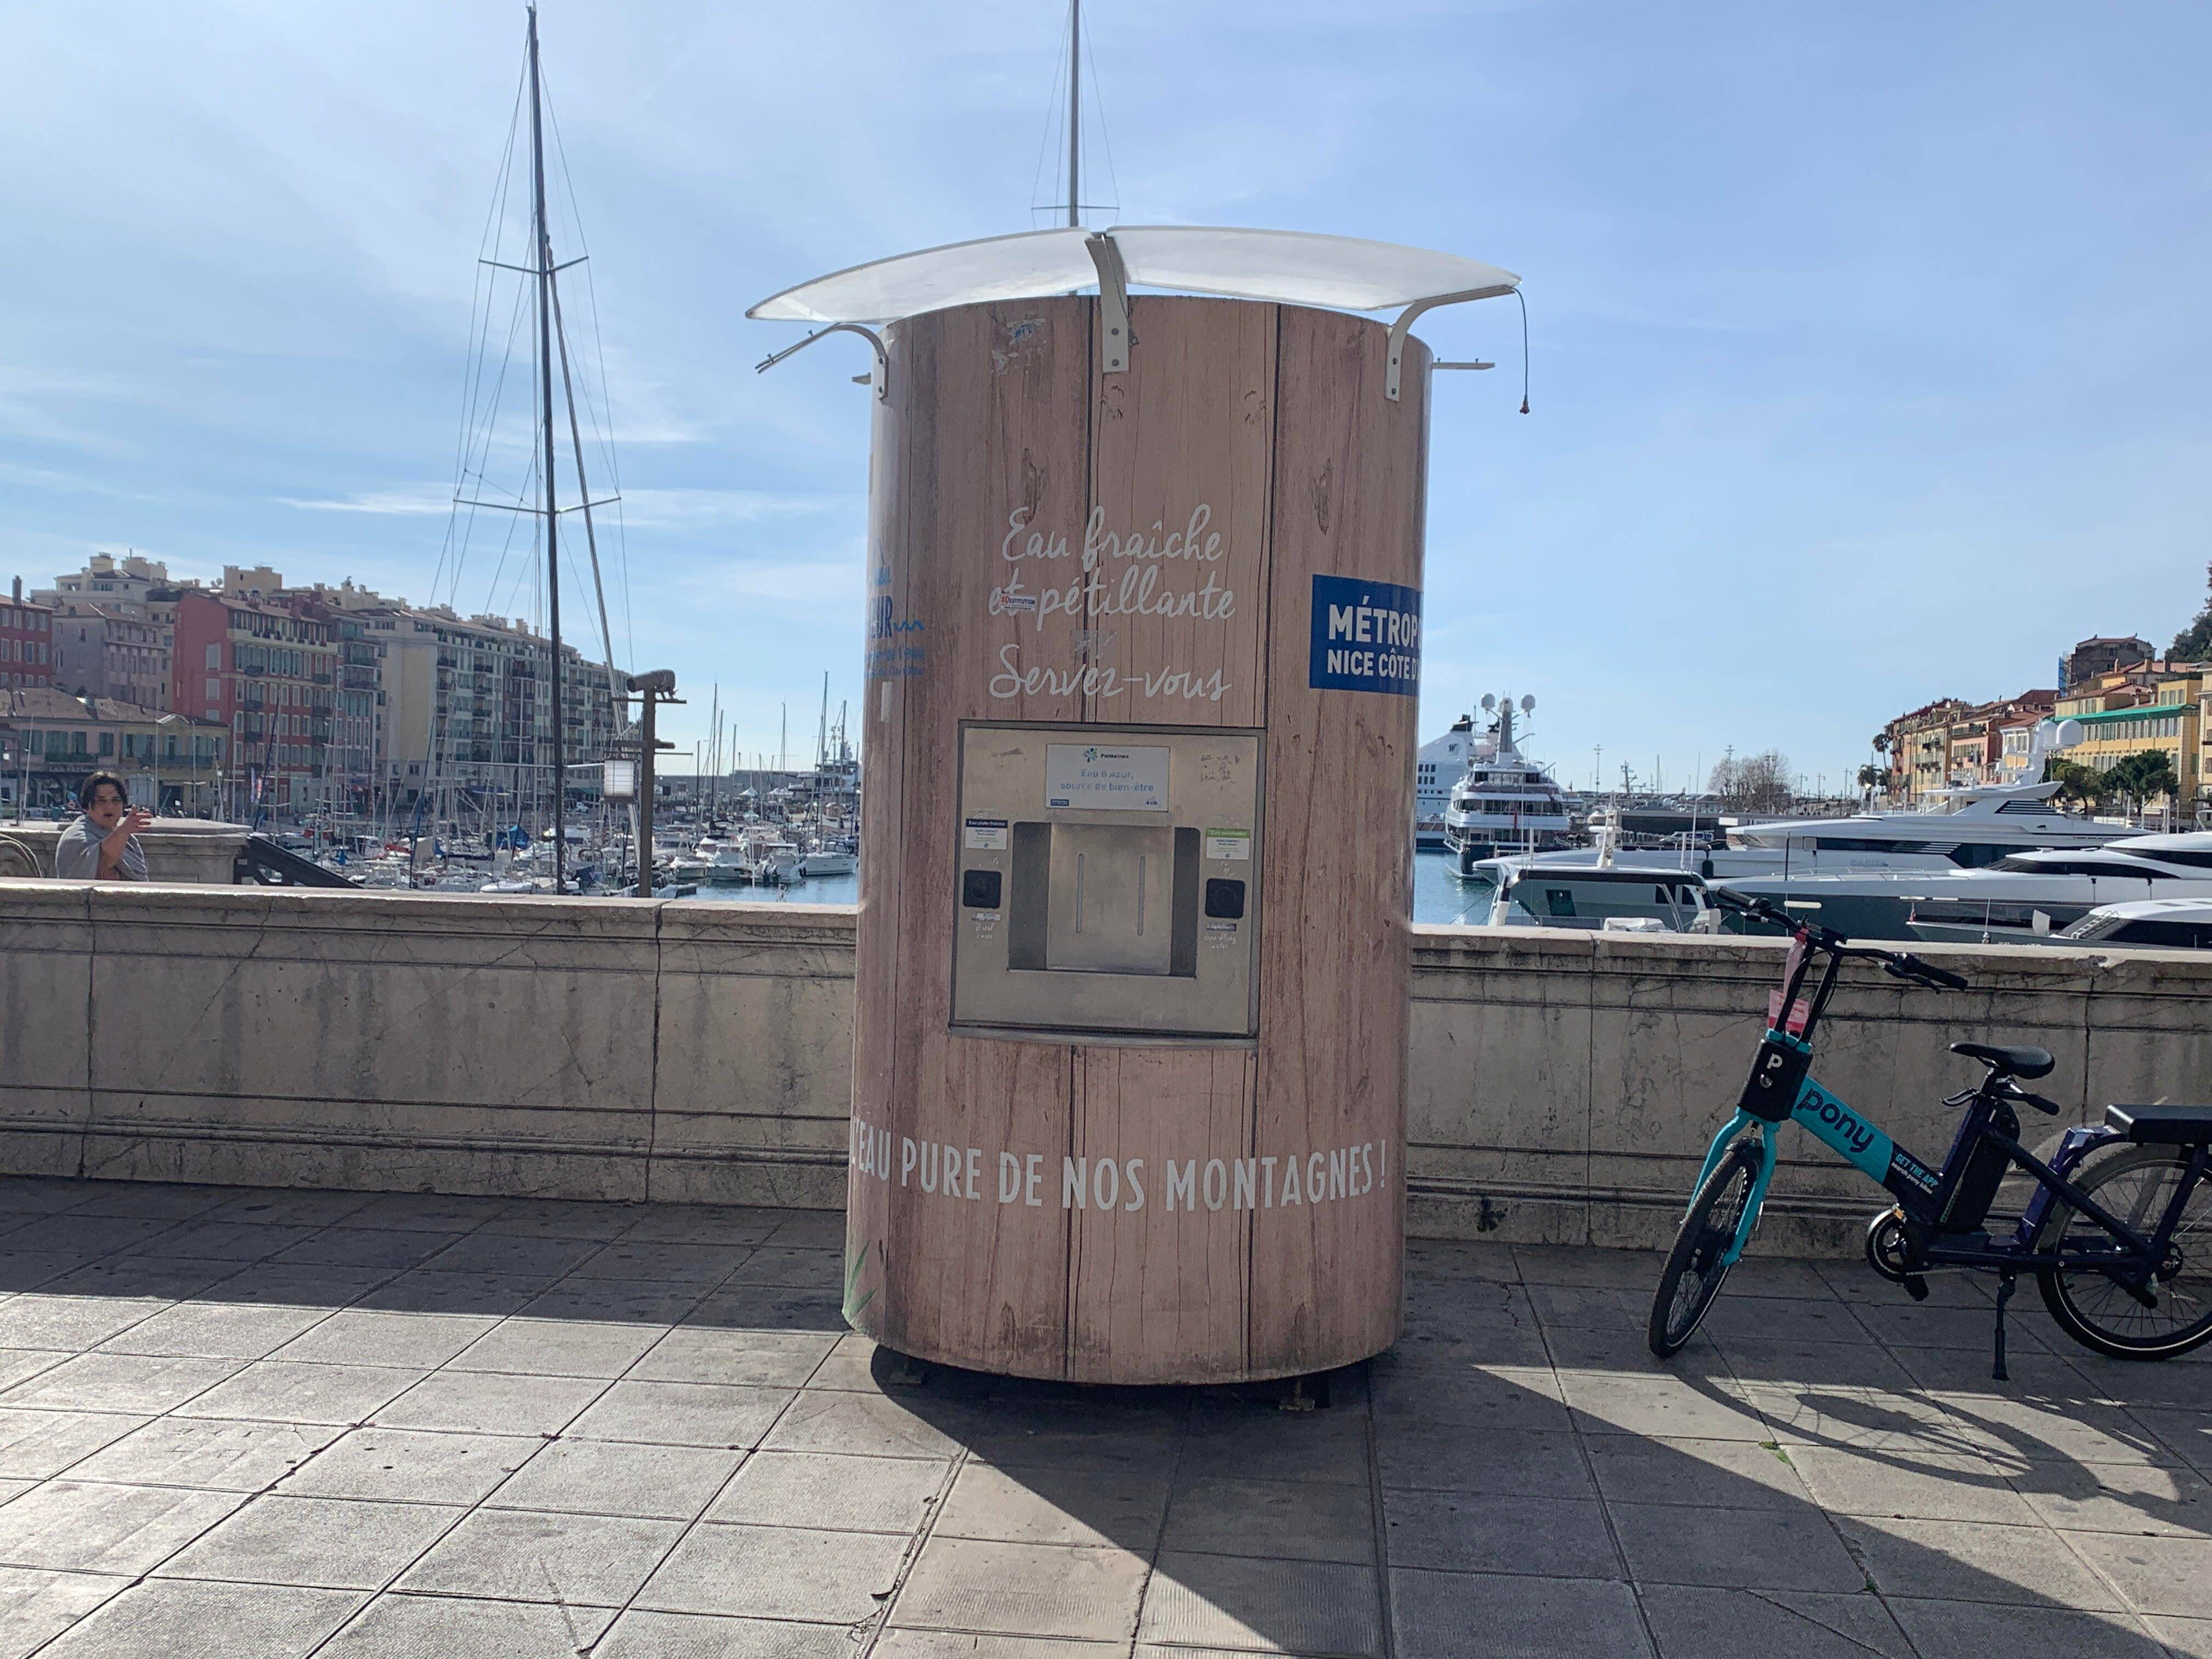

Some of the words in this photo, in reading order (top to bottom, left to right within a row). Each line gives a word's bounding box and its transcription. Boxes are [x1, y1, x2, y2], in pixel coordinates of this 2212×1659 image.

[1002, 506, 1070, 561] Eau
[1082, 504, 1223, 572] fraîche
[1037, 565, 1236, 631] pétillante
[989, 644, 1232, 701] Servez-vous
[1327, 649, 1374, 676] NICE
[1378, 648, 1410, 679] CÔTE
[1081, 769, 1098, 778] Eau
[1109, 782, 1154, 792] bien-être
[1767, 1053, 1783, 1069] P
[1795, 1088, 1875, 1154] pony
[901, 1136, 982, 1200] PURE
[998, 1151, 1043, 1207] DE
[1062, 1156, 1146, 1211] NOS
[1895, 1154, 1911, 1167] GET
[1909, 1163, 1925, 1178] THE
[1922, 1174, 1939, 1188] APP
